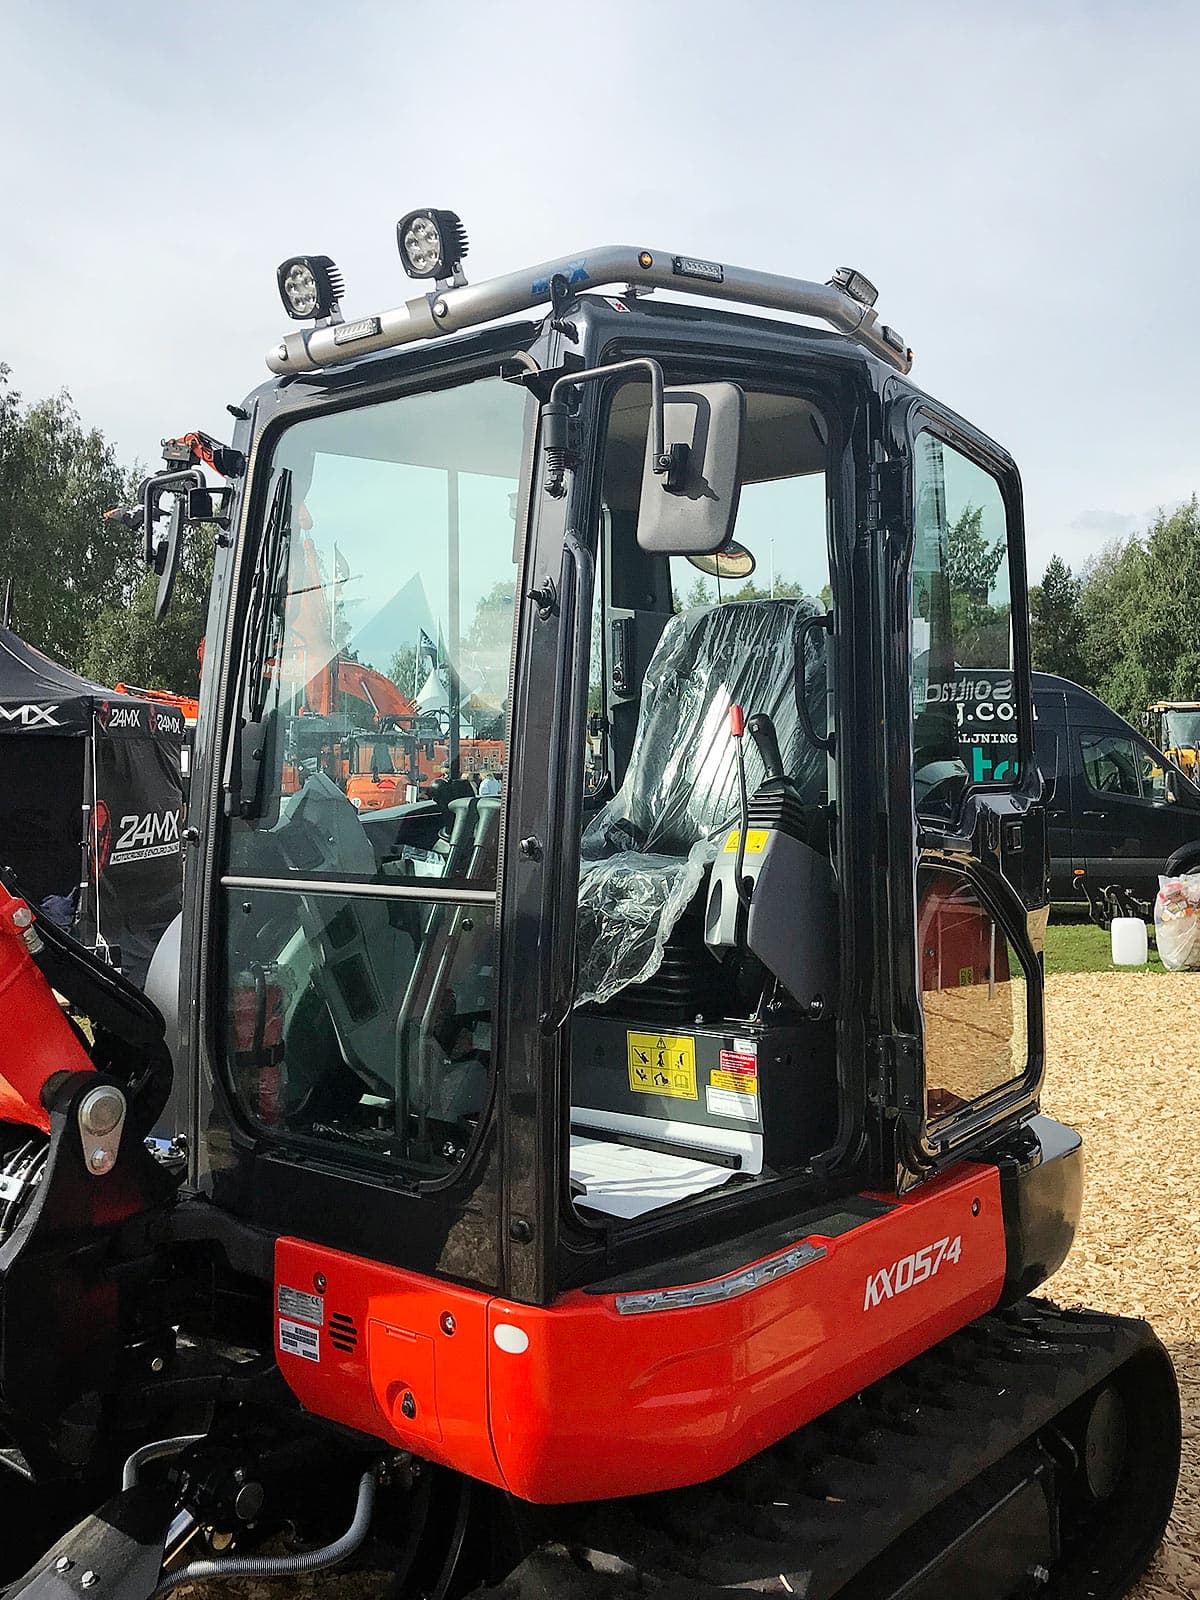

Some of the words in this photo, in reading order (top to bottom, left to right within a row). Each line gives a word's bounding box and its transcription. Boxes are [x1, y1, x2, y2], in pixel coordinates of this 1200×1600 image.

[0, 704, 60, 726] MX
[108, 708, 141, 728] 24MX
[156, 714, 181, 734] 24MX
[115, 809, 180, 849] 24MX
